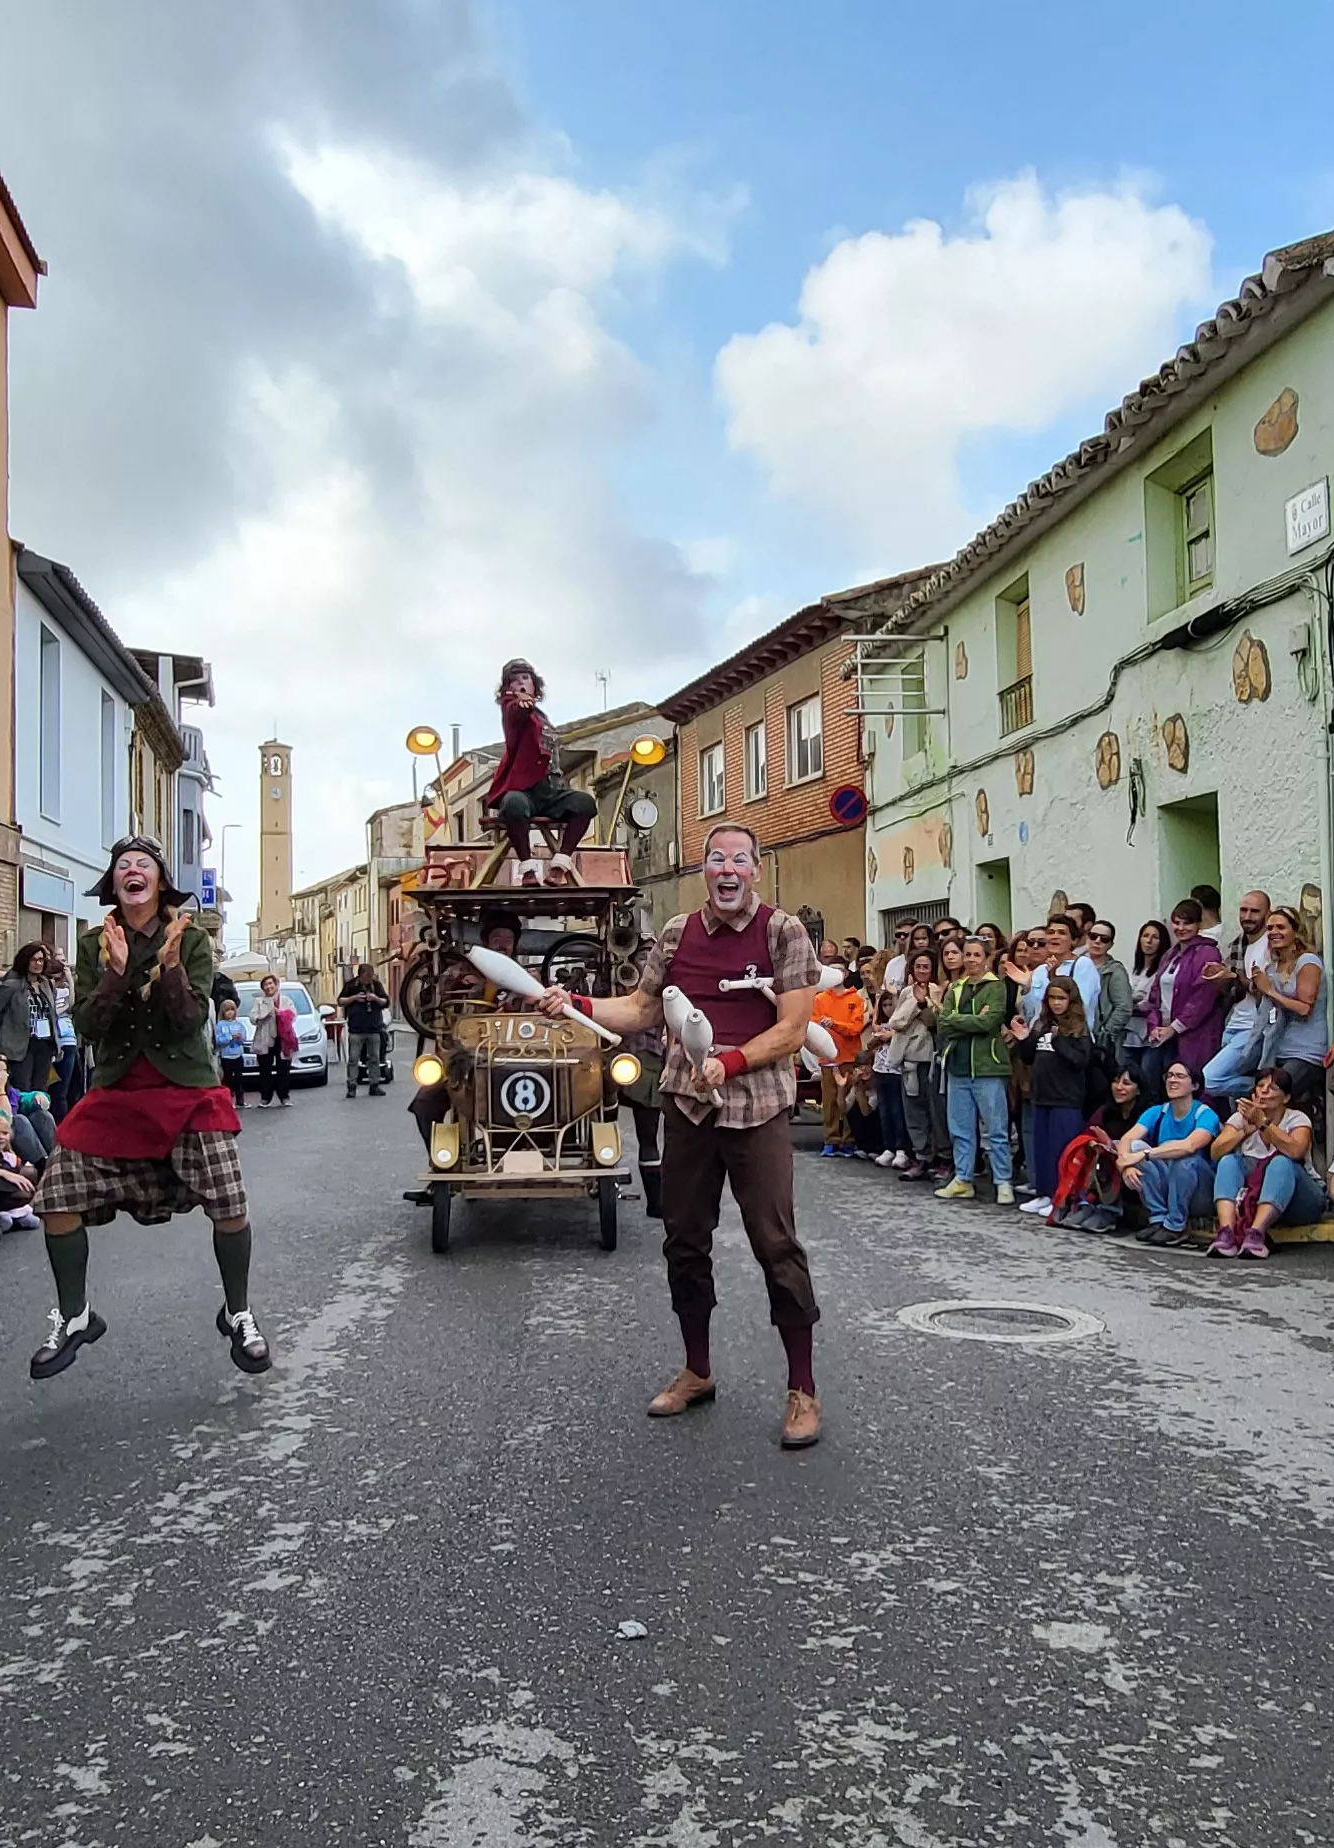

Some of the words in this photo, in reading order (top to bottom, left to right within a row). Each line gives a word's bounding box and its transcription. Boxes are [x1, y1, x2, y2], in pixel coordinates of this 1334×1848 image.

[1300, 493, 1321, 513] Calle
[1292, 514, 1323, 540] Mayor
[744, 964, 758, 981] 3
[514, 1078, 537, 1111] 8
